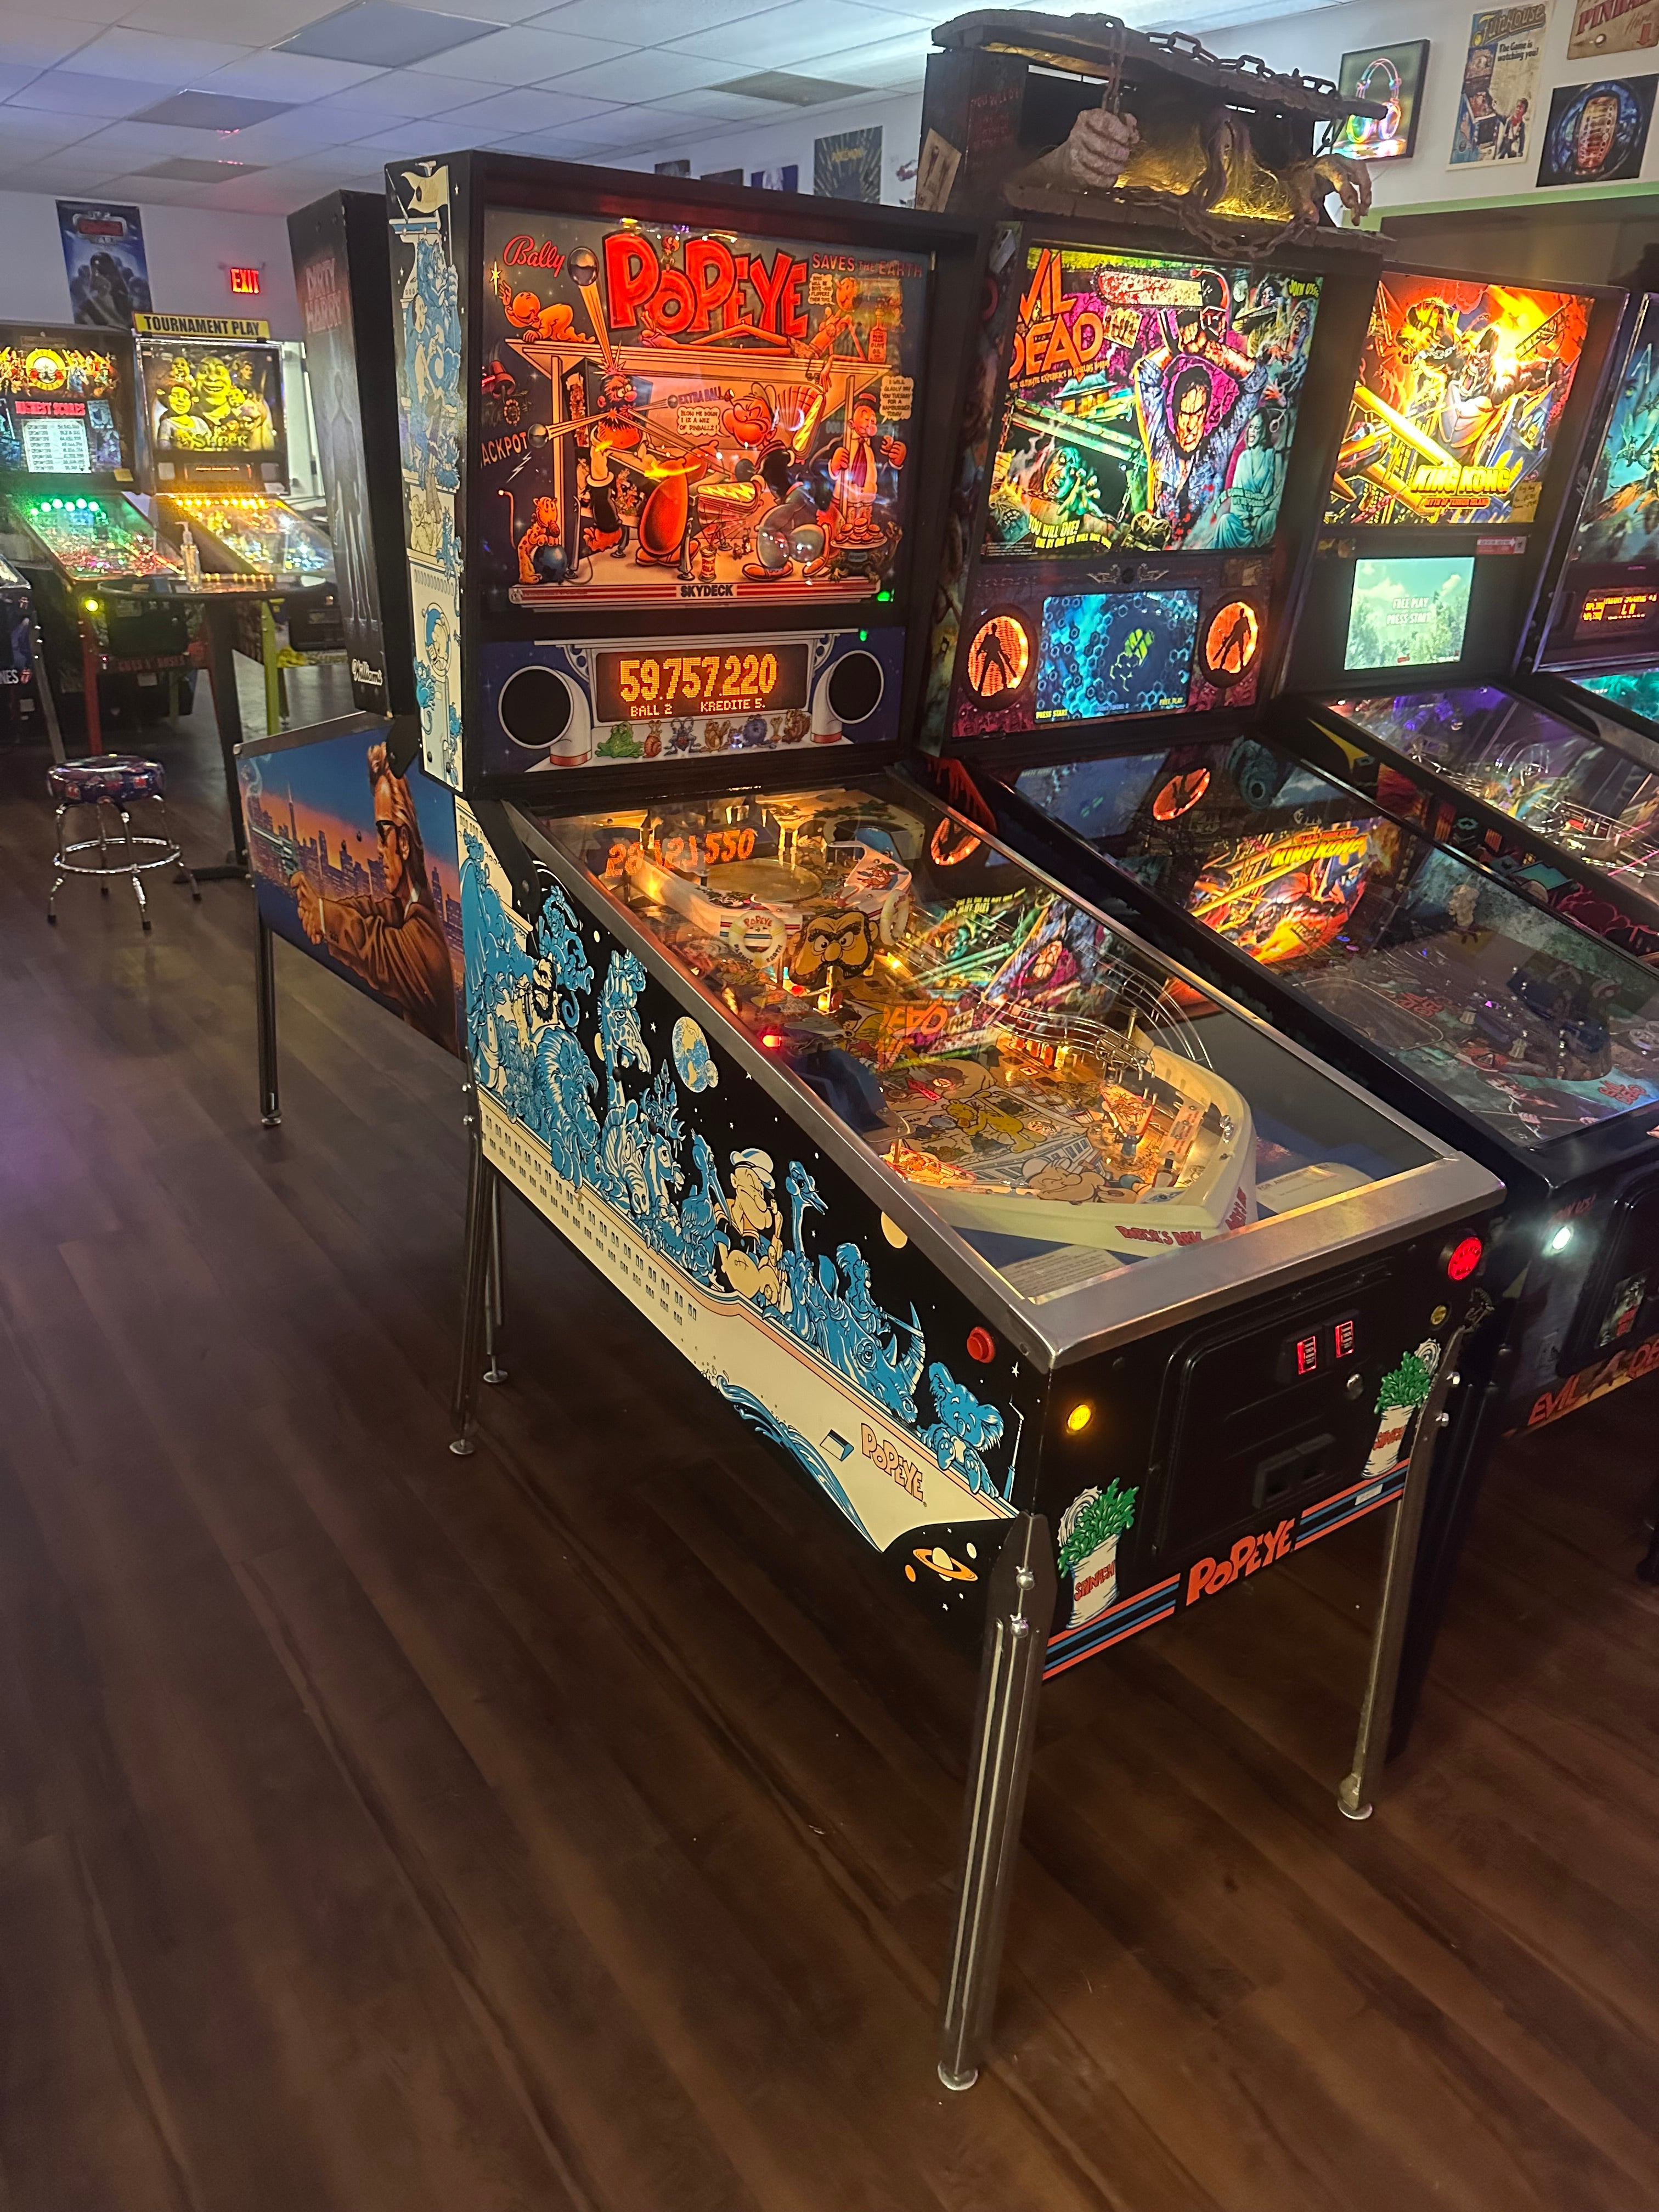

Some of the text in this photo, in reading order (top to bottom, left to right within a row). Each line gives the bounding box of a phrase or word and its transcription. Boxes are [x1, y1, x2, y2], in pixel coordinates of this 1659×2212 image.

[503, 234, 566, 278] Bally
[812, 253, 855, 272] SAVES
[878, 261, 923, 278] EARTH
[230, 268, 259, 294] EXIT
[602, 230, 809, 338] POPEYE
[144, 315, 259, 336] TOURNAMENT PLAY
[678, 386, 725, 404] EXTRA BALL
[1410, 466, 1510, 496] KING KONG
[1029, 514, 1081, 538] YOU WILL DIE!
[680, 584, 733, 597] SKYDECK
[1392, 597, 1430, 610] FREE PLAY
[1409, 612, 1432, 624] START
[630, 703, 673, 717] BALL 2
[700, 698, 751, 712] KREDITE
[743, 915, 772, 927] POPEYE
[1528, 1374, 1581, 1425] EVIL
[1072, 1412, 1088, 1424] START
[861, 1423, 924, 1503] POPEYE
[1186, 1518, 1294, 1606] POPEYE
[1074, 1561, 1115, 1602] SPINACH
